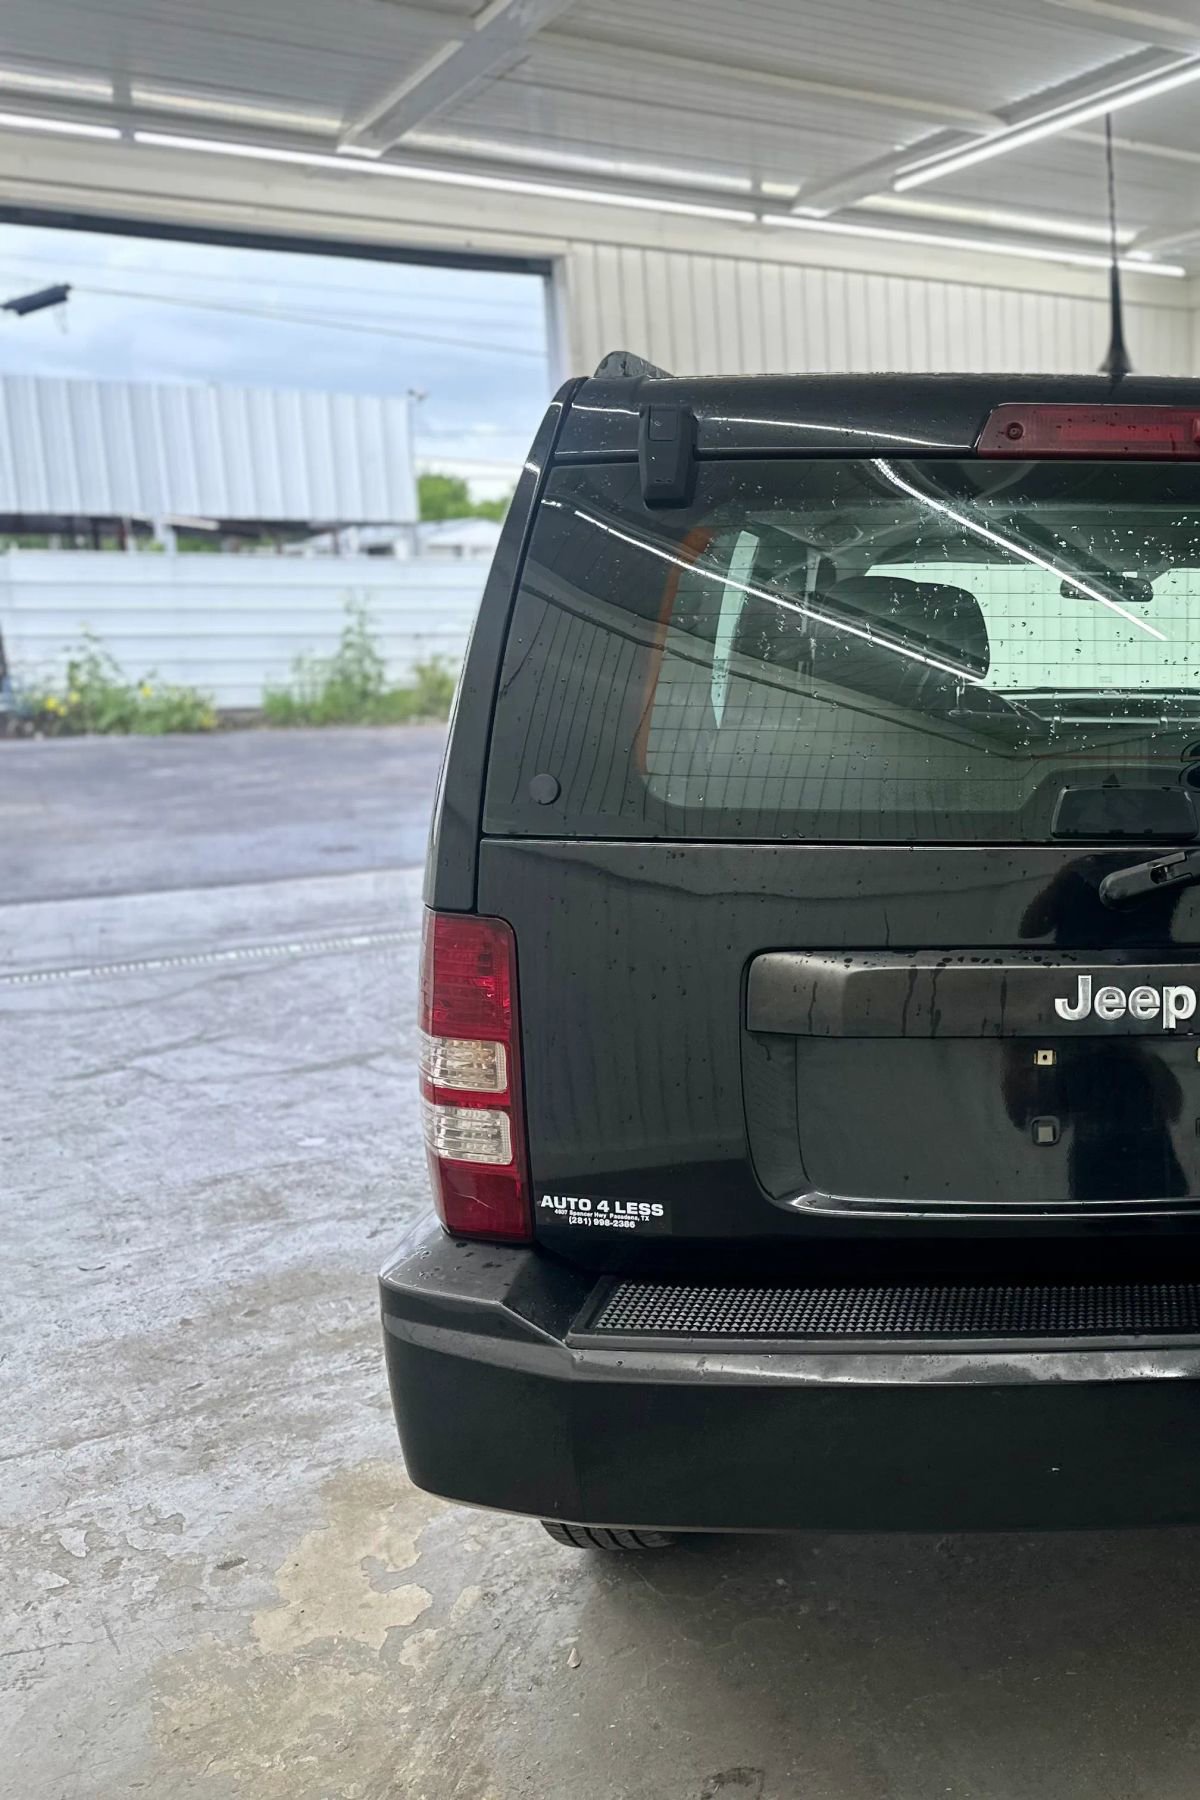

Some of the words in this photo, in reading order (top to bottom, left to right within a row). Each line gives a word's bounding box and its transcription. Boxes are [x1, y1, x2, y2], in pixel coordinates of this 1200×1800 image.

[1054, 974, 1197, 1030] Jeep
[540, 1195, 592, 1211] AUTO
[596, 1200, 610, 1213] 4
[615, 1201, 664, 1217] LESS
[568, 1216, 592, 1226] (281)
